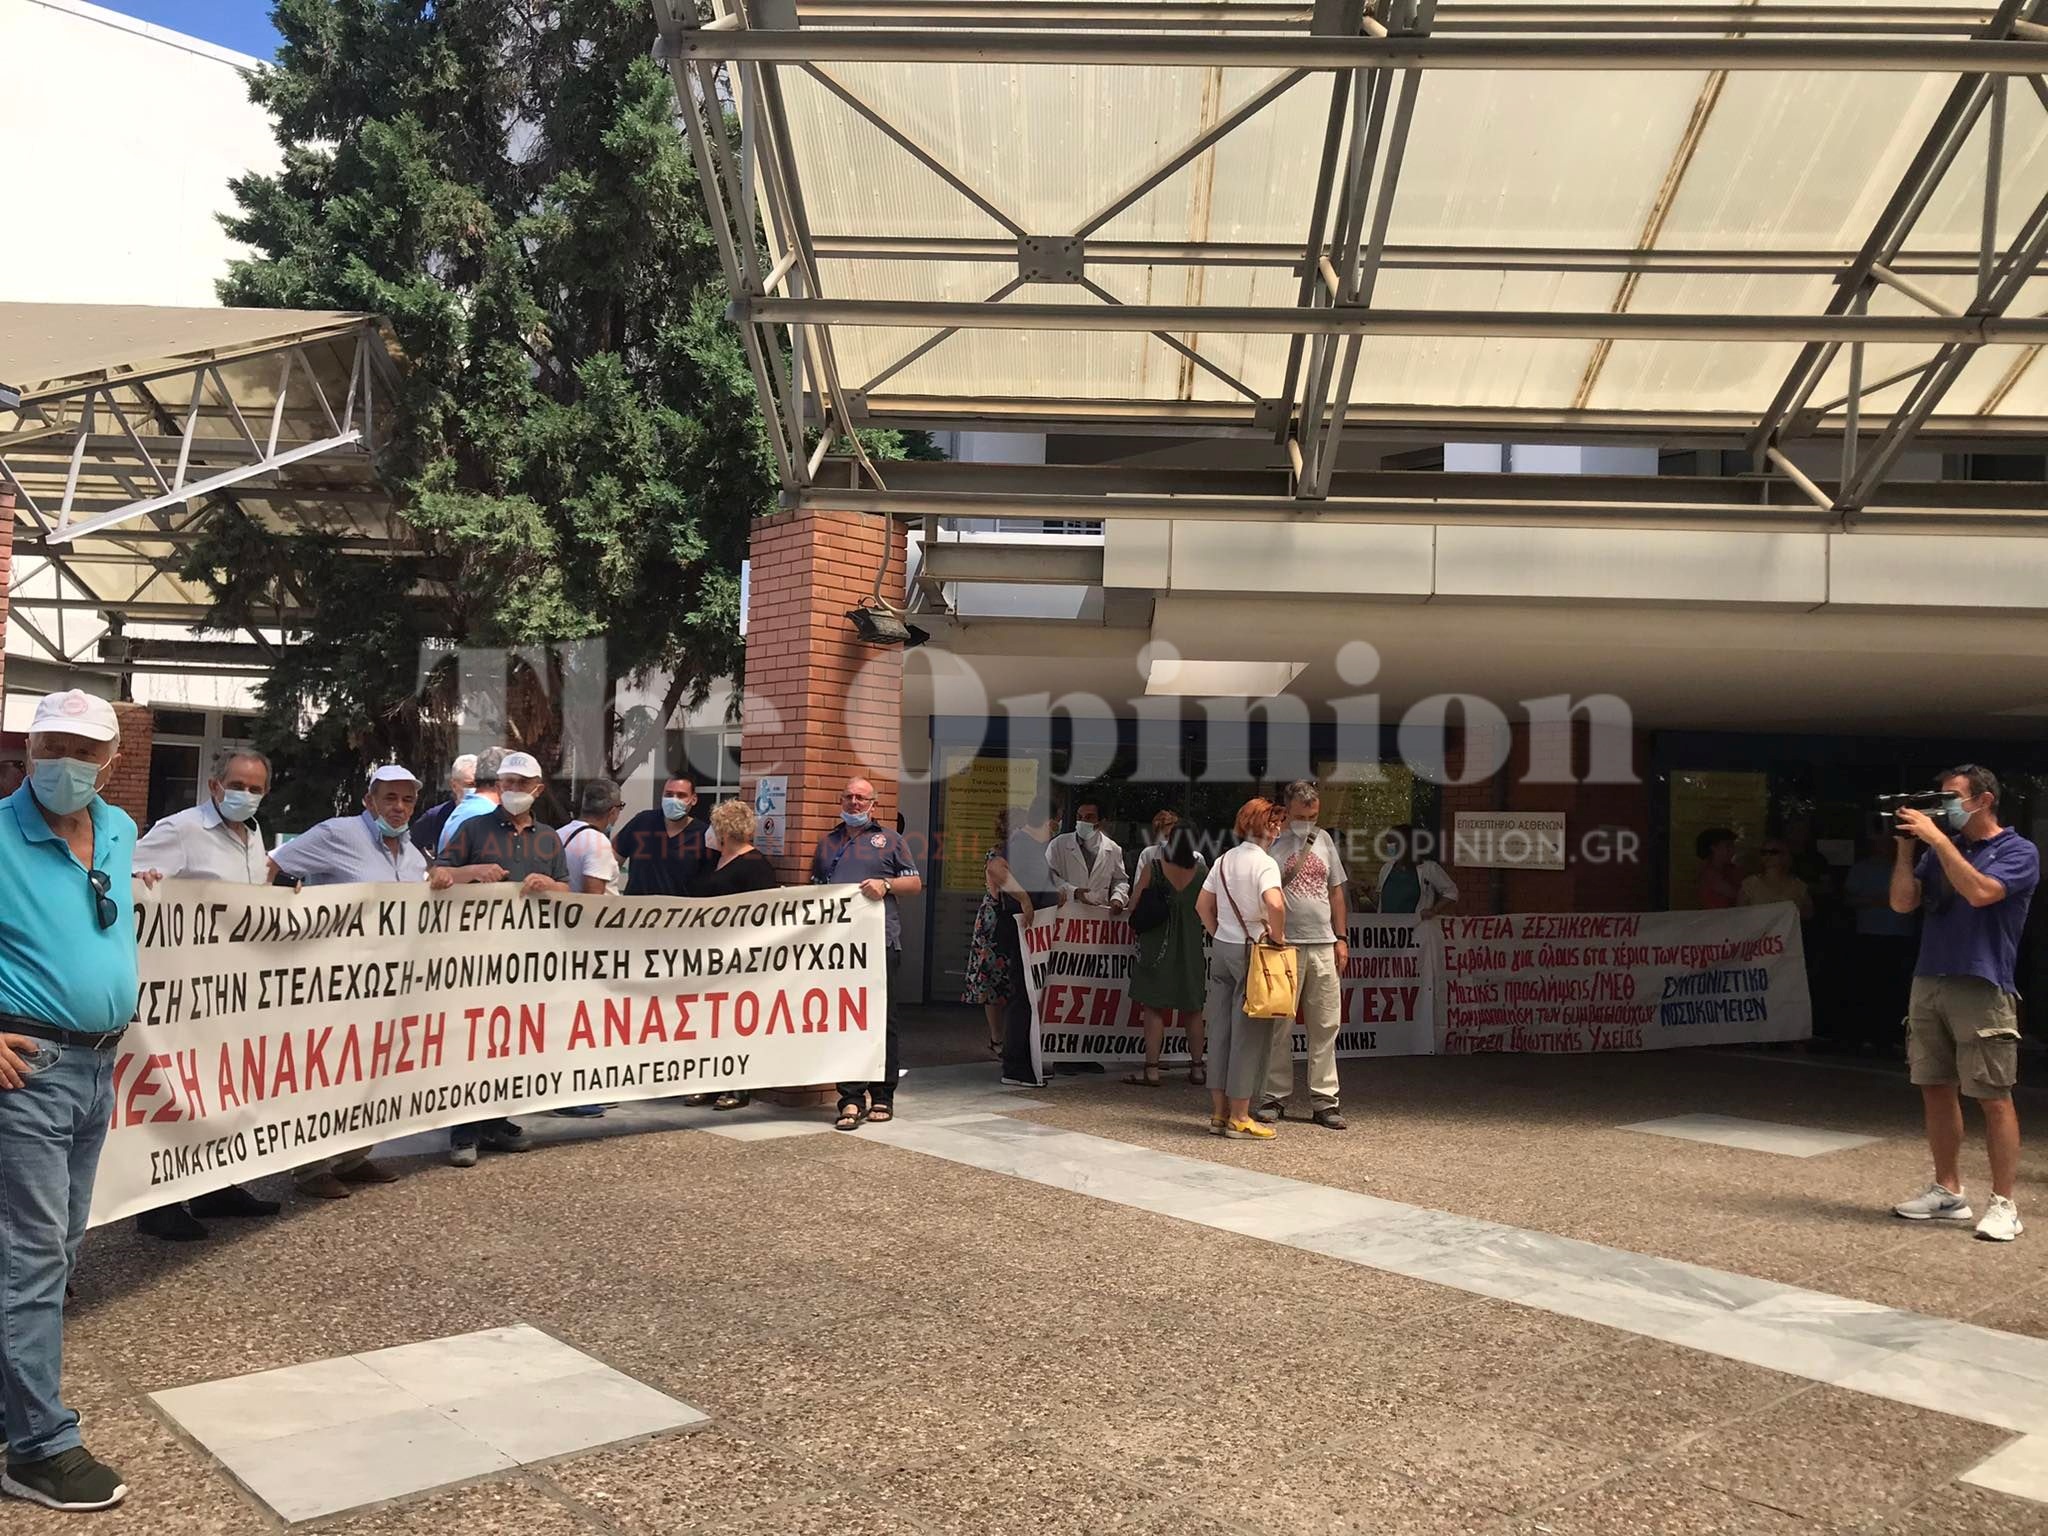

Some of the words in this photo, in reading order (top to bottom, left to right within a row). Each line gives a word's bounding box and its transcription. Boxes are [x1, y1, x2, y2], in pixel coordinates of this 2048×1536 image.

[1456, 819, 1516, 831] ΕΠΙΣΚΕΠΤΗΡΙΟ
[1518, 819, 1564, 831] ΑΣΘΕΝΩΝ
[193, 902, 227, 944] ΩΣ
[229, 903, 364, 942] ΔΙΚΑΙΩΜΑ
[378, 900, 405, 936] ΚΙ
[418, 901, 451, 933] ΟΧΙ
[459, 898, 583, 932] ΕΡΓΑΛΕΙΟ
[594, 898, 852, 928] ΙΔΙΩΤΙΚΟΠΟΙΗΣΗΣ
[1363, 927, 1420, 948] ΘΙΑΣΟΣ.
[1441, 918, 1454, 940] Η
[1462, 917, 1514, 940] ΥΓΕΙΑ
[1048, 951, 1109, 978] ΜΟΝΙΜΕΣ
[1392, 957, 1420, 978] ΜΑΣ.
[1511, 949, 1535, 976] για
[1538, 942, 1579, 969] όλους
[1583, 947, 1609, 968] στα
[1613, 942, 1649, 972] χέρια
[190, 972, 247, 1020] ΣΤΗΝ
[258, 950, 629, 1009] ΣΤΕΛΕΧΩΣΗ-ΜΟΝΙΜΟΠΟΙΗΣΗ
[644, 942, 867, 978] ΣΥΜΒΑΣΙΟΥΧΩΝ
[1662, 968, 1768, 1000] ΣΥΝΤΟΝΙΣΤΙΚΟ
[1040, 985, 1122, 1025] ΕΣΗ
[1363, 986, 1420, 1023] ΕΣΥ
[1661, 997, 1768, 1027] ΝΟΣΟΚΟΜΕΙΩΝ
[218, 1012, 445, 1112] ΑΝΑΚΛΗΣΗ
[464, 1002, 545, 1061] ΤΩΝ
[567, 987, 868, 1050] ΑΝΑΣΤΟΛΩΝ
[151, 1133, 247, 1185] ΣΩΜΑΤΕΙΟ
[254, 1095, 401, 1156] ΕΡΓΑΖΟΜΕΝΩΝ
[410, 1072, 562, 1117] ΝΟΣΟΚΟΜΕΙΟΥ
[573, 1054, 750, 1089] ΠΑΠΑΓΕΩΡΓΙΟΥ
